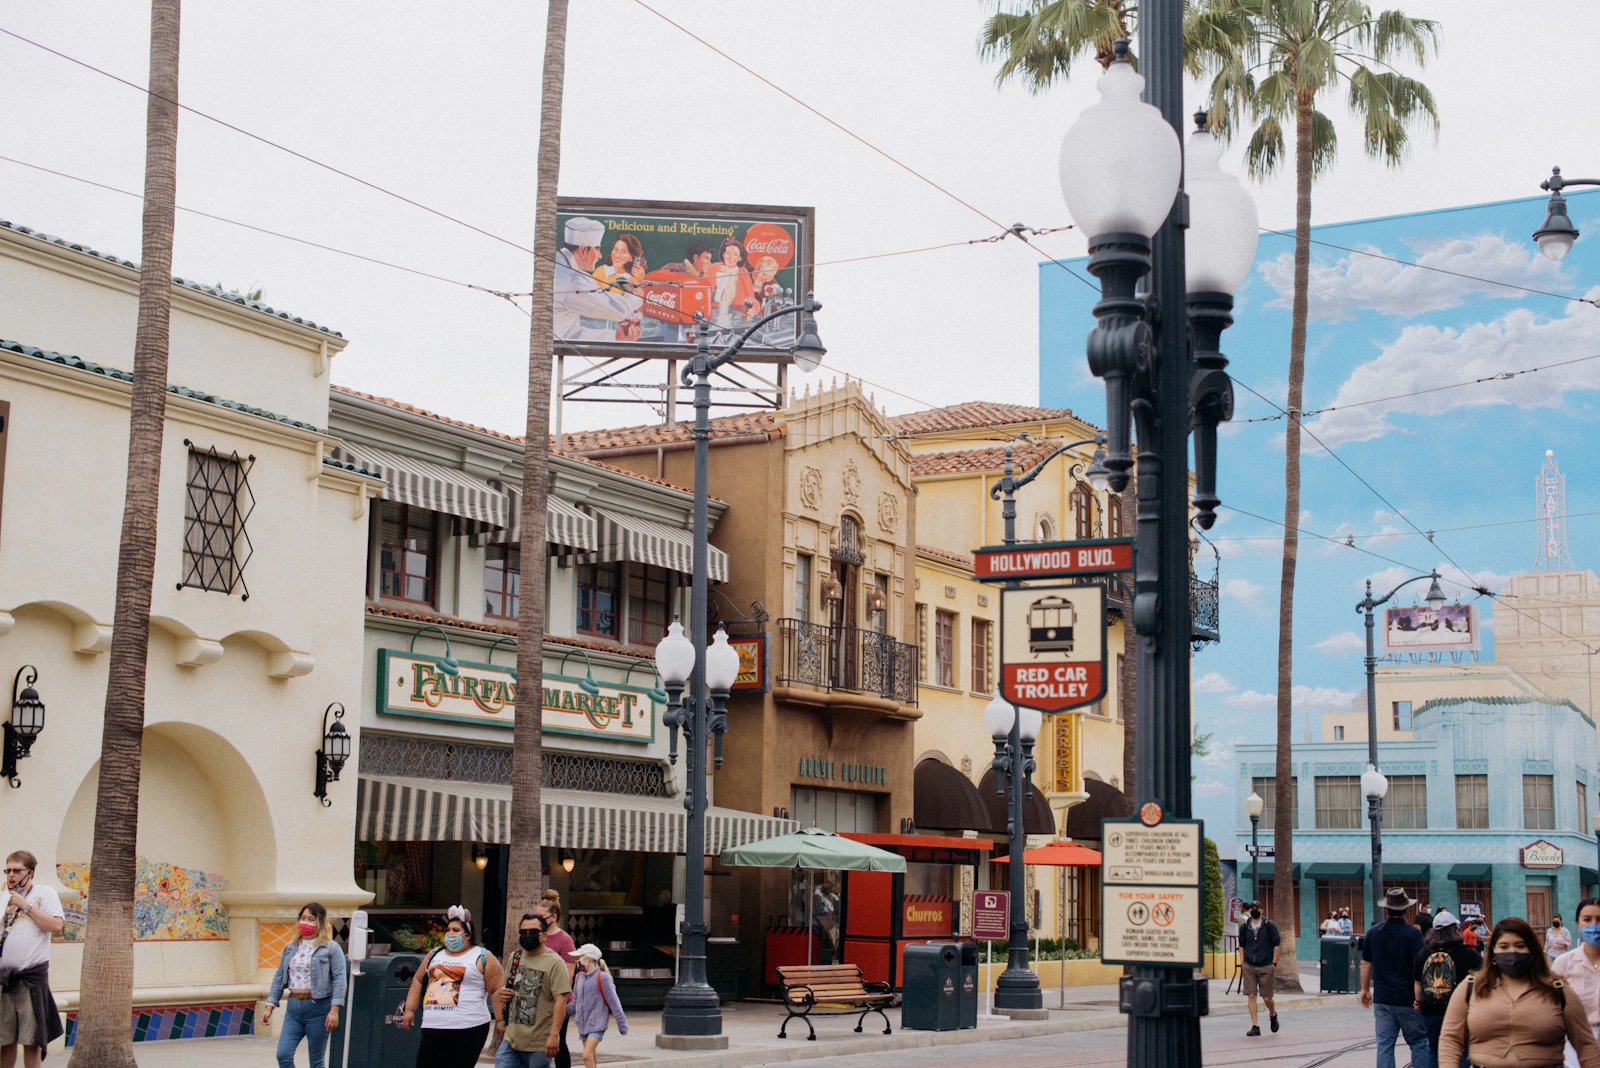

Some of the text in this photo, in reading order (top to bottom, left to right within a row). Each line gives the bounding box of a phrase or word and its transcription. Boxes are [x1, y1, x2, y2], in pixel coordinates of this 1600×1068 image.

[657, 222, 678, 234] and
[657, 310, 675, 319] COLD
[990, 548, 1116, 573] HOLLYWOOD BLVD.
[1016, 666, 1087, 683] RED CAR
[1014, 682, 1089, 699] TROLLEY
[542, 687, 638, 729] MARKET
[1055, 717, 1070, 790] CARPETS
[800, 756, 887, 785] ARGYLE BUILDING
[1525, 850, 1561, 863] Beverly
[1135, 892, 1155, 900] YOUR
[1158, 893, 1184, 901] SAFETY
[906, 905, 943, 922] Churros
